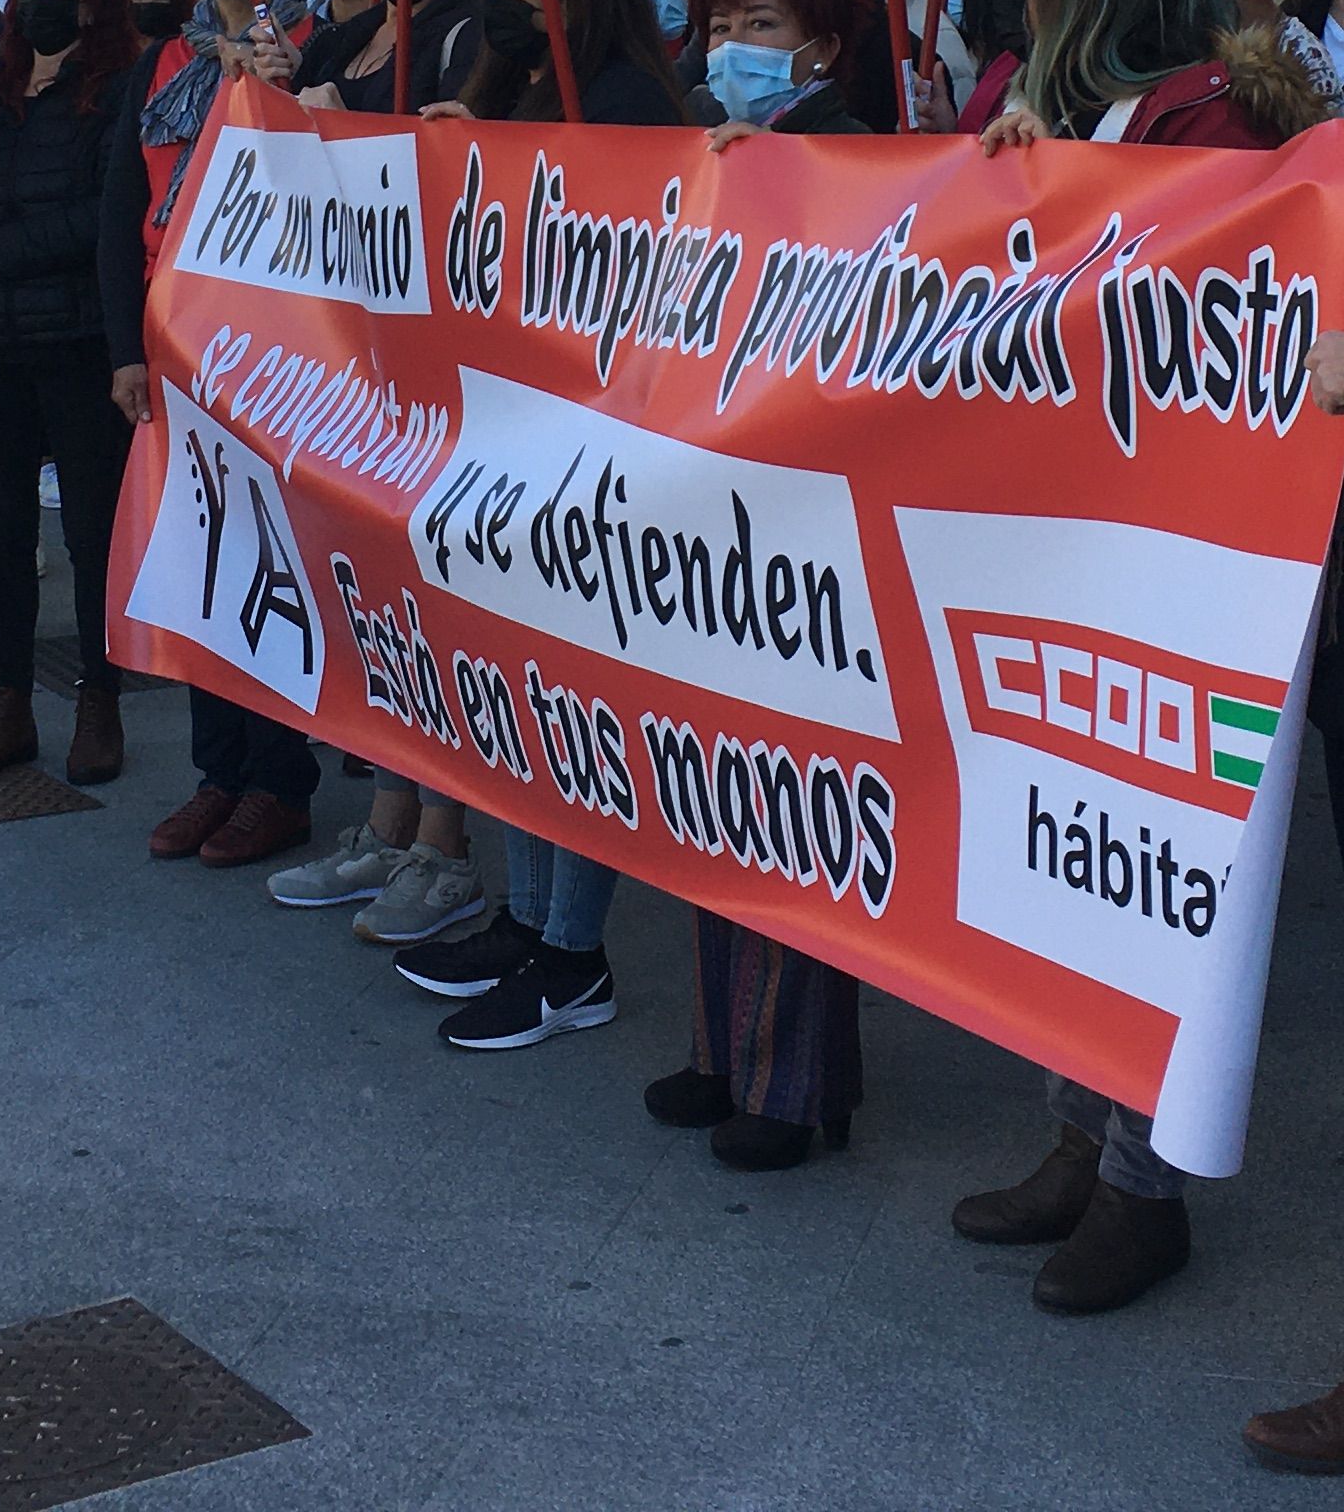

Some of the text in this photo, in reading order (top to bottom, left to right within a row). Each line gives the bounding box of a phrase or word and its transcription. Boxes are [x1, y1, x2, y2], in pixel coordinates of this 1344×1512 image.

[196, 148, 277, 267] Por
[268, 193, 312, 279] un
[446, 142, 505, 319] de
[521, 149, 742, 387] limpieza
[716, 202, 1121, 415] provincial
[1098, 224, 1318, 458] justo
[191, 324, 252, 410] se
[230, 345, 449, 493] conquistan
[465, 472, 527, 573] se
[531, 443, 878, 682] defienden.
[330, 551, 896, 920] Está en tus manos
[972, 632, 1197, 774] CCOO
[1028, 783, 1233, 938] hábita
